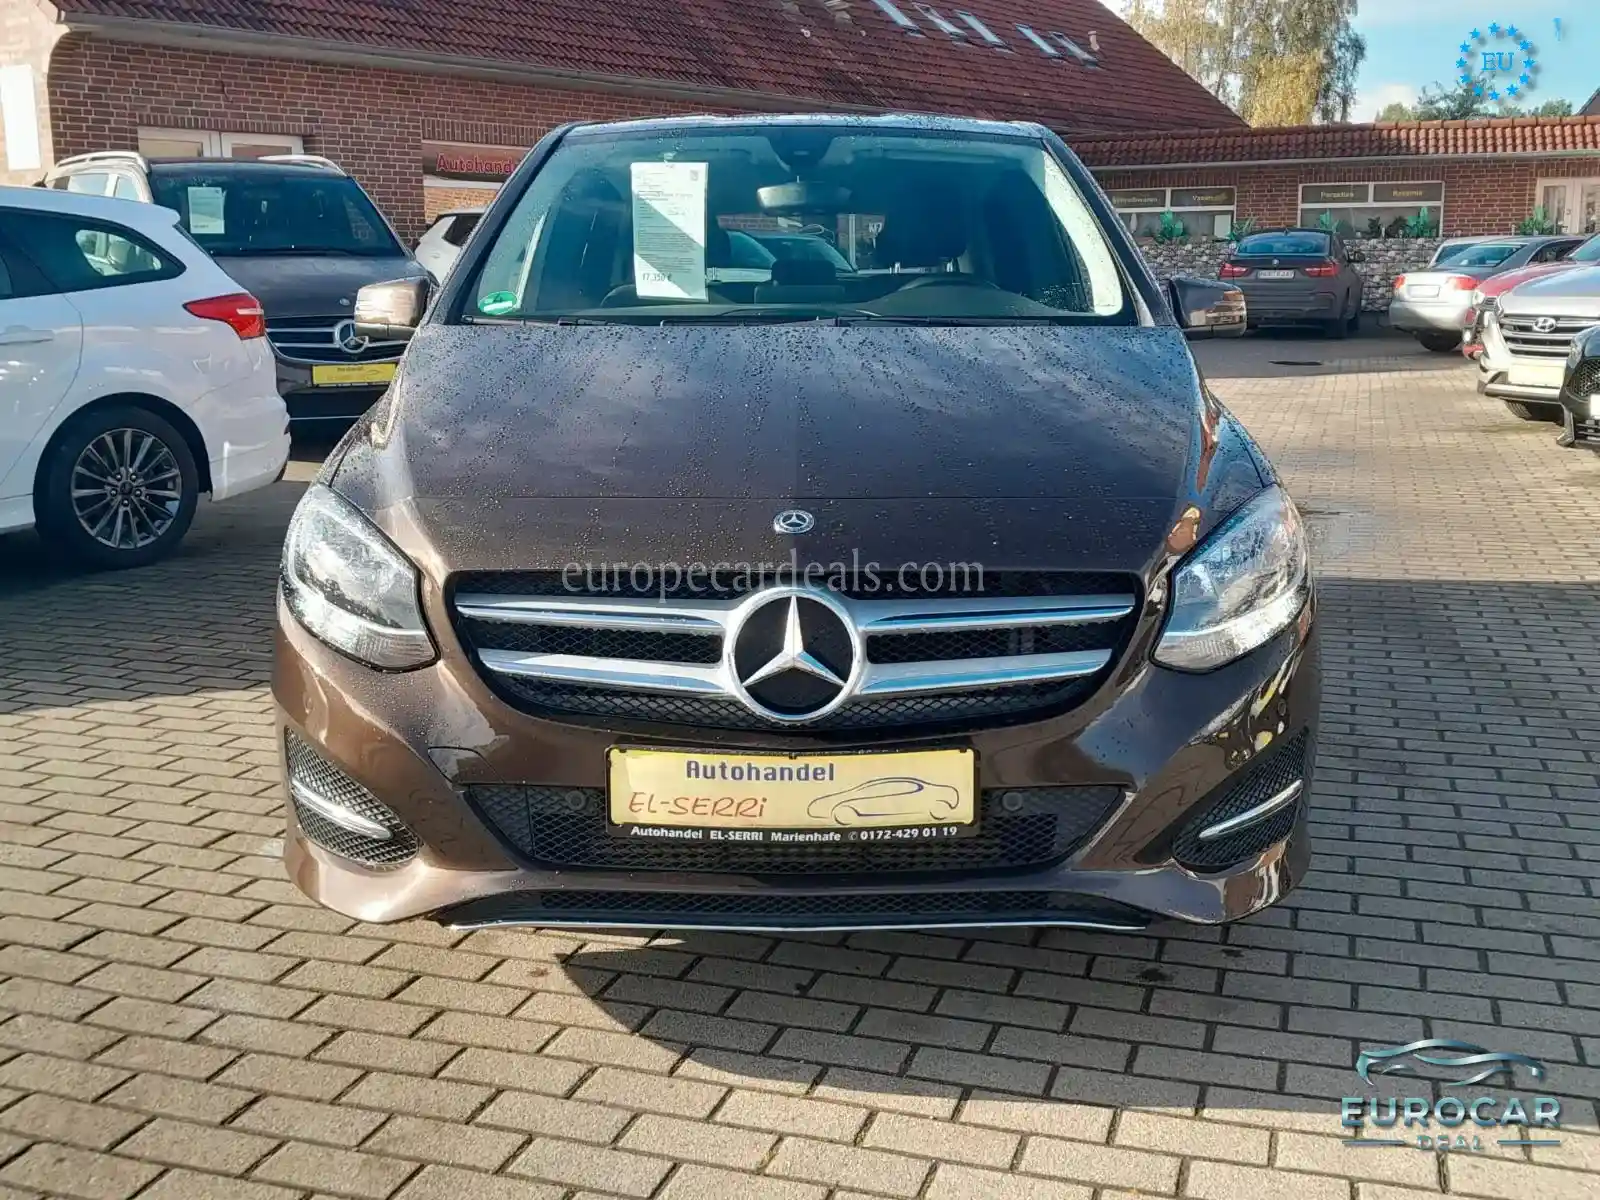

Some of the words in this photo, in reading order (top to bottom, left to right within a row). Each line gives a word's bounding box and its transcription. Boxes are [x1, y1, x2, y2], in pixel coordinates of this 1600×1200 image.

[436, 152, 516, 174] Autohand
[686, 760, 835, 782] Autohandel
[630, 826, 703, 840] Autohandel
[709, 830, 764, 841] EL-SERRI
[770, 831, 842, 842] Marienhafe
[859, 828, 919, 841] 0172-429
[922, 827, 938, 838] 01
[943, 826, 958, 837] 19
